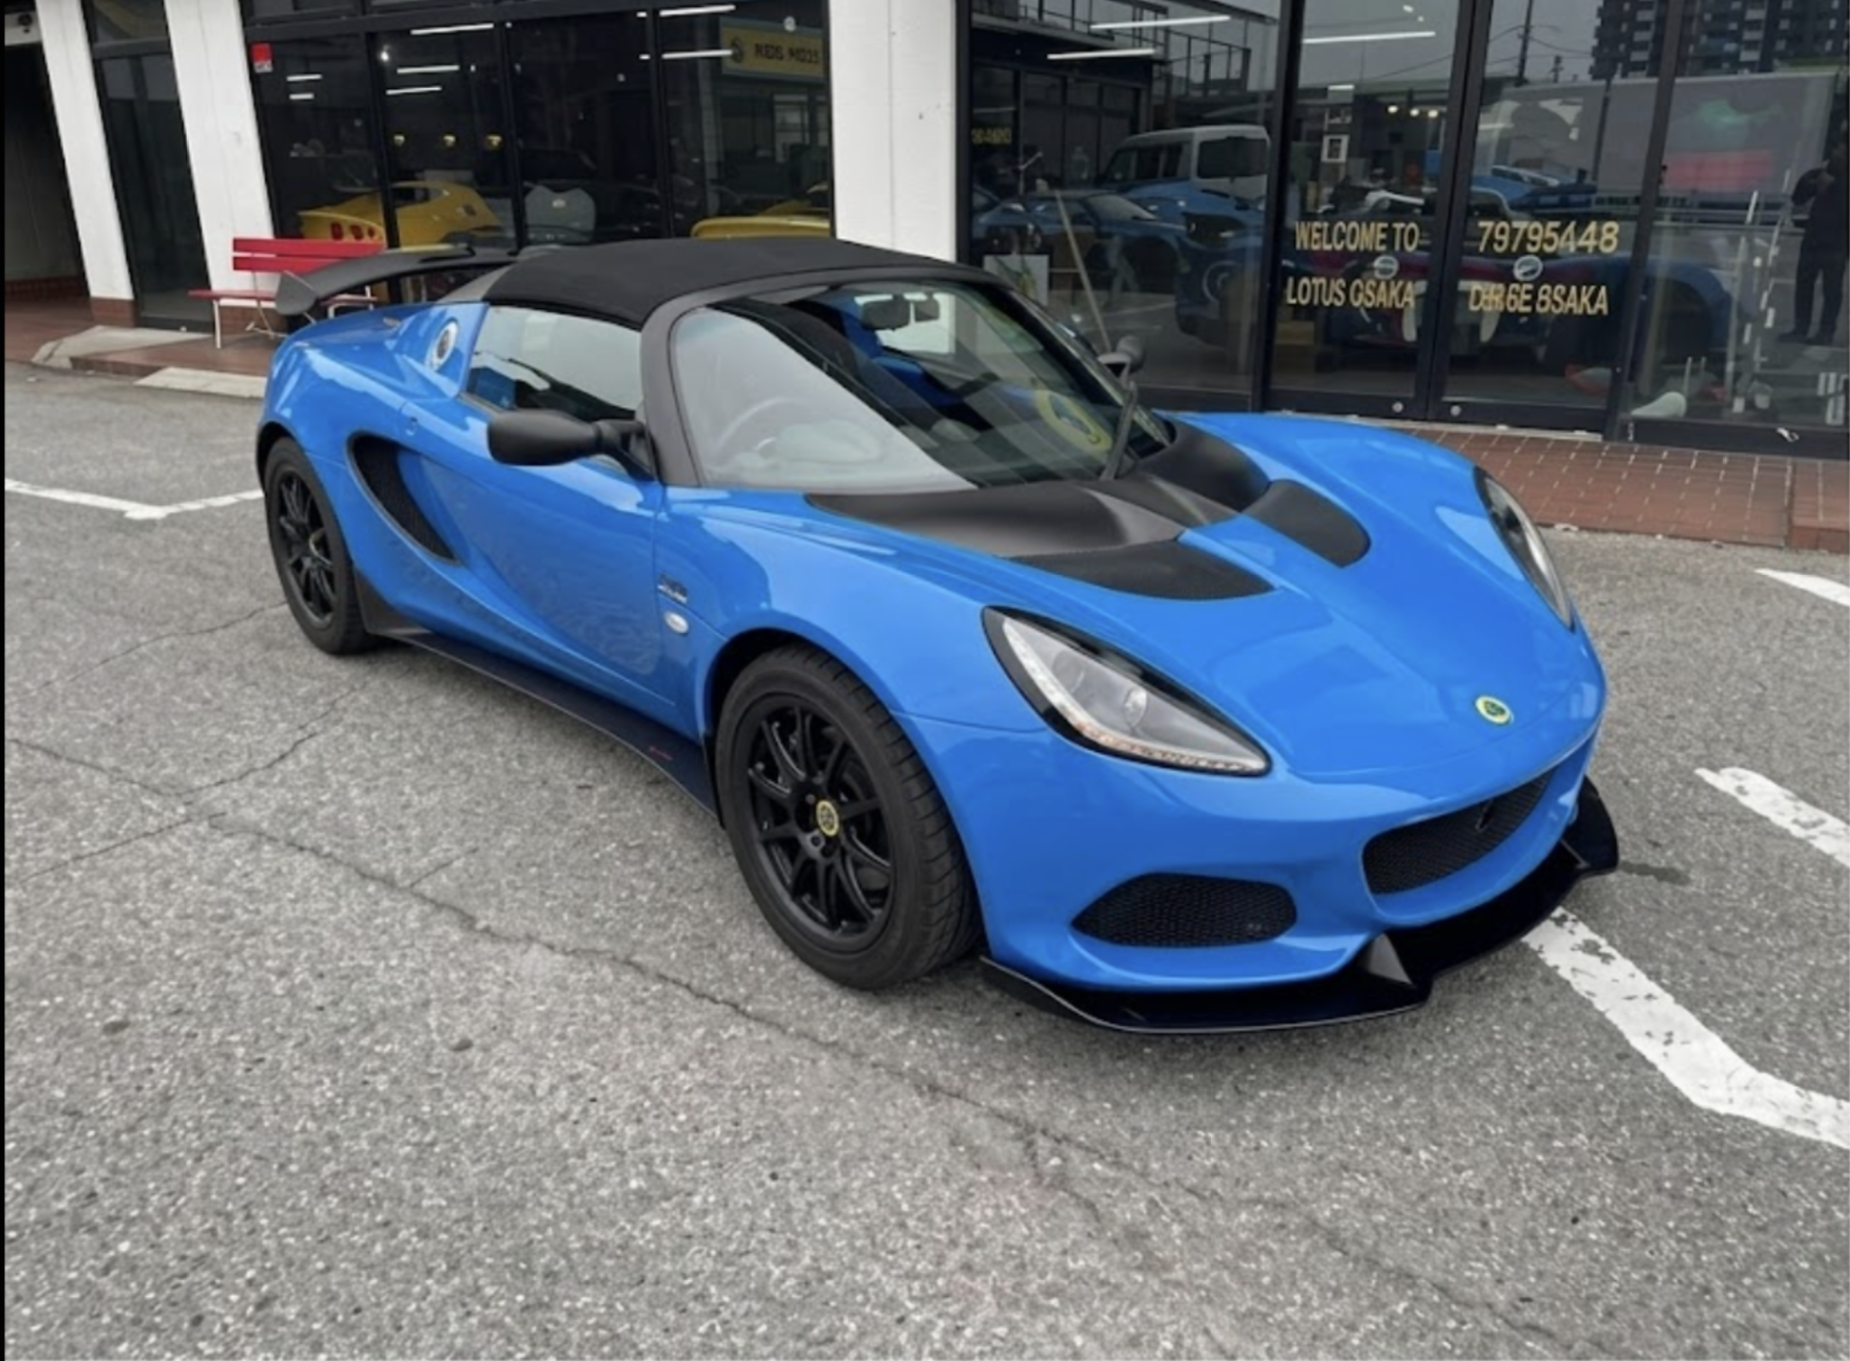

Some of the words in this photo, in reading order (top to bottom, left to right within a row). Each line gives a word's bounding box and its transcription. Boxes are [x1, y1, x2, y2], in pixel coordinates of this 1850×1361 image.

[1295, 221, 1388, 251] WELCOME
[1392, 222, 1419, 252] TO
[1286, 277, 1346, 306] LOTUS
